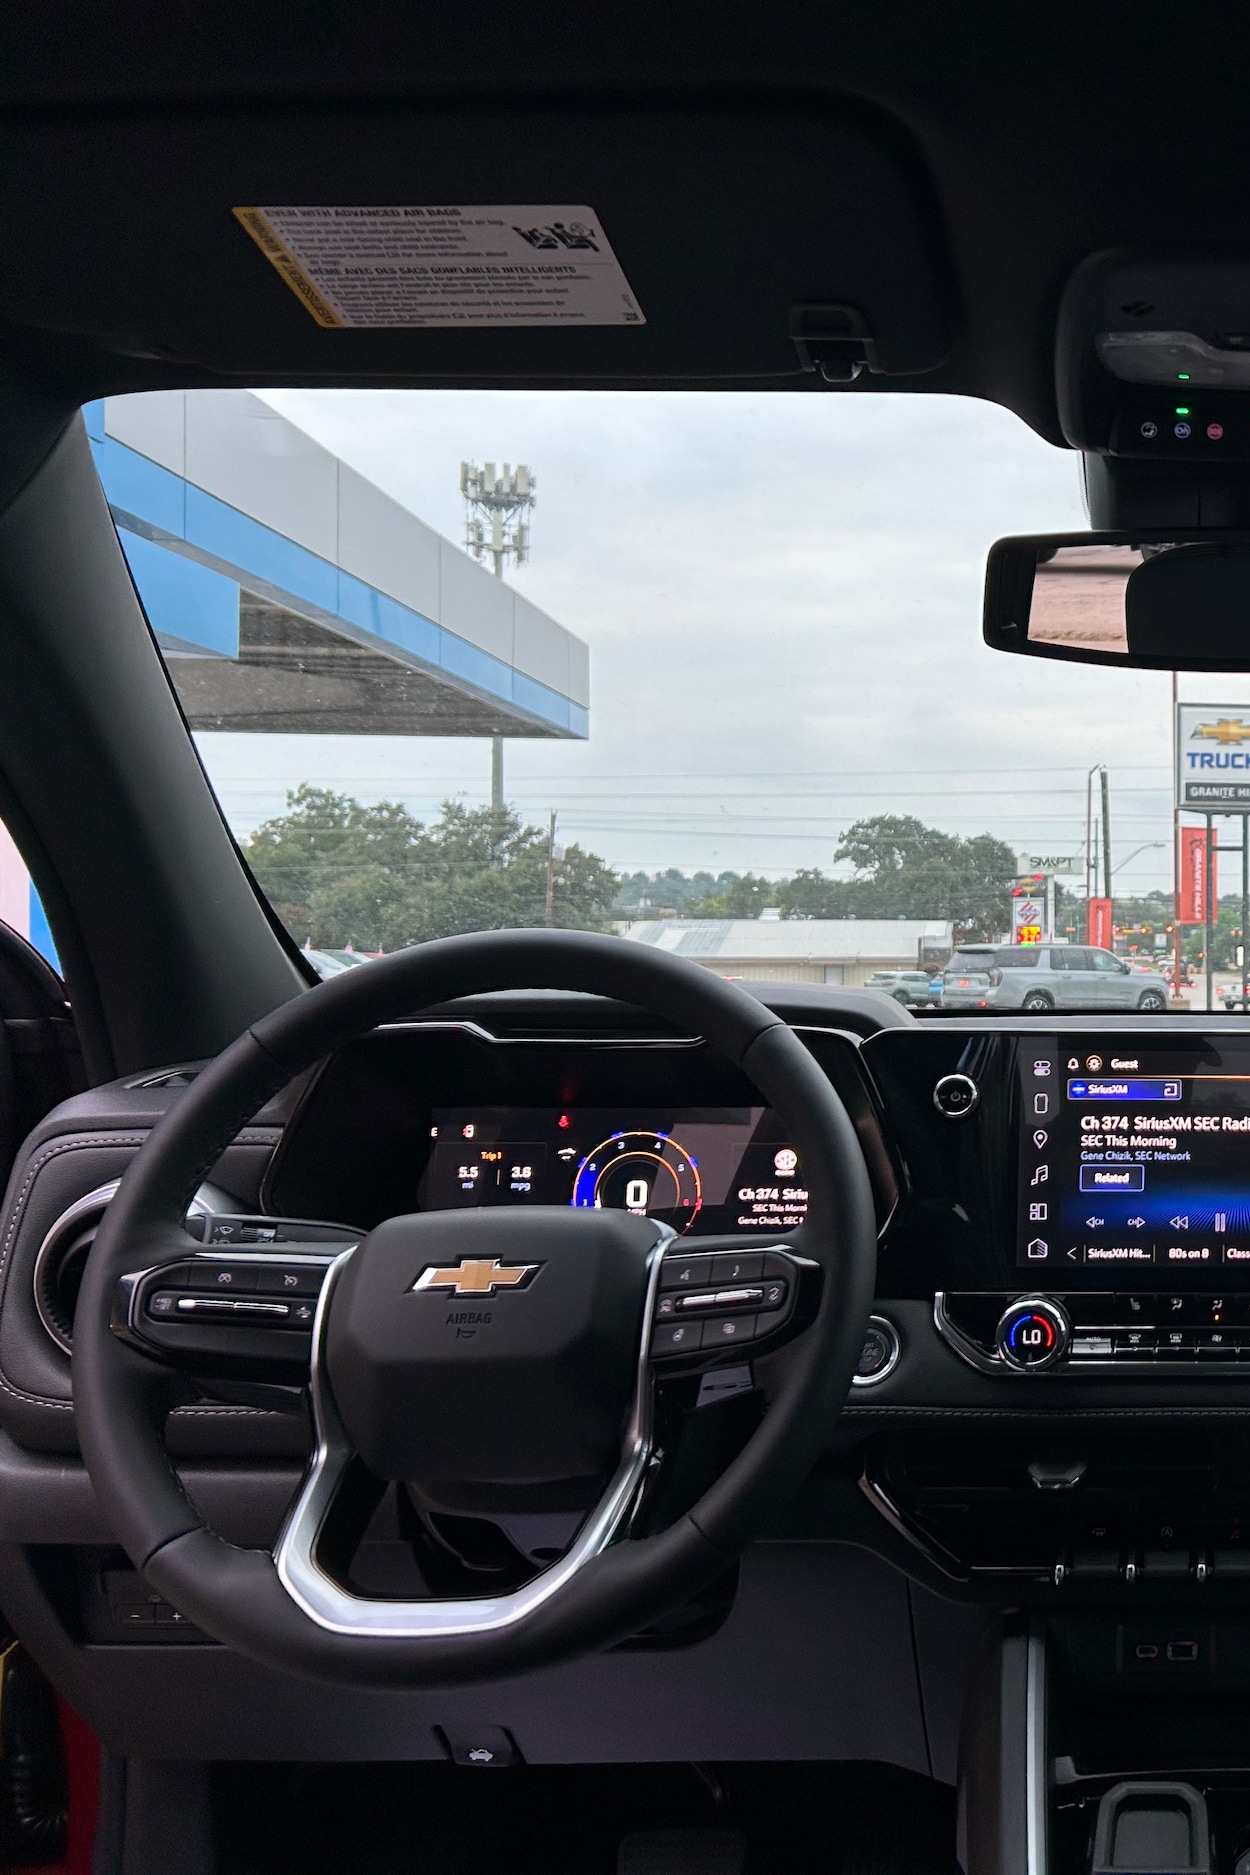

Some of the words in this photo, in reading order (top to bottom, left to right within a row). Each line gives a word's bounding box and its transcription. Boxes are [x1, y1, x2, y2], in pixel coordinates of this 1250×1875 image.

[1190, 785, 1236, 799] GRANITE
[1111, 1058, 1139, 1071] Guest
[1088, 1084, 1129, 1096] SiriusXM
[1080, 1115, 1100, 1131] Ch
[1101, 1115, 1130, 1131] 374
[1134, 1115, 1193, 1131] SiriusXM
[1193, 1115, 1220, 1131] SEC
[431, 1127, 439, 1137] E
[618, 1141, 627, 1150] 3
[653, 1141, 663, 1150] 4
[1080, 1133, 1104, 1148] SEC
[1105, 1133, 1129, 1148] This
[1130, 1133, 1178, 1150] Morning
[481, 1151, 497, 1161] Trip
[1080, 1151, 1104, 1161] Gene
[1105, 1151, 1134, 1161] Chizik,
[1134, 1151, 1153, 1161] SEC
[1154, 1151, 1192, 1161] Network
[459, 1166, 480, 1179] 5.5
[589, 1163, 598, 1172] 2
[677, 1164, 686, 1173] 5
[1094, 1172, 1131, 1184] Related
[510, 1182, 532, 1192] mpg
[626, 1179, 649, 1209] 0
[738, 1188, 755, 1202] Ch
[755, 1188, 779, 1201] 374
[782, 1188, 809, 1201] Siriu
[752, 1203, 770, 1213] SEC
[770, 1203, 785, 1213] This
[783, 1215, 800, 1225] SEC
[1088, 1247, 1129, 1260] SiriusXM
[1129, 1247, 1152, 1260] Hit...
[1188, 1249, 1200, 1260] on
[446, 1311, 492, 1325] AIRBAG
[1022, 1329, 1042, 1345] LO
